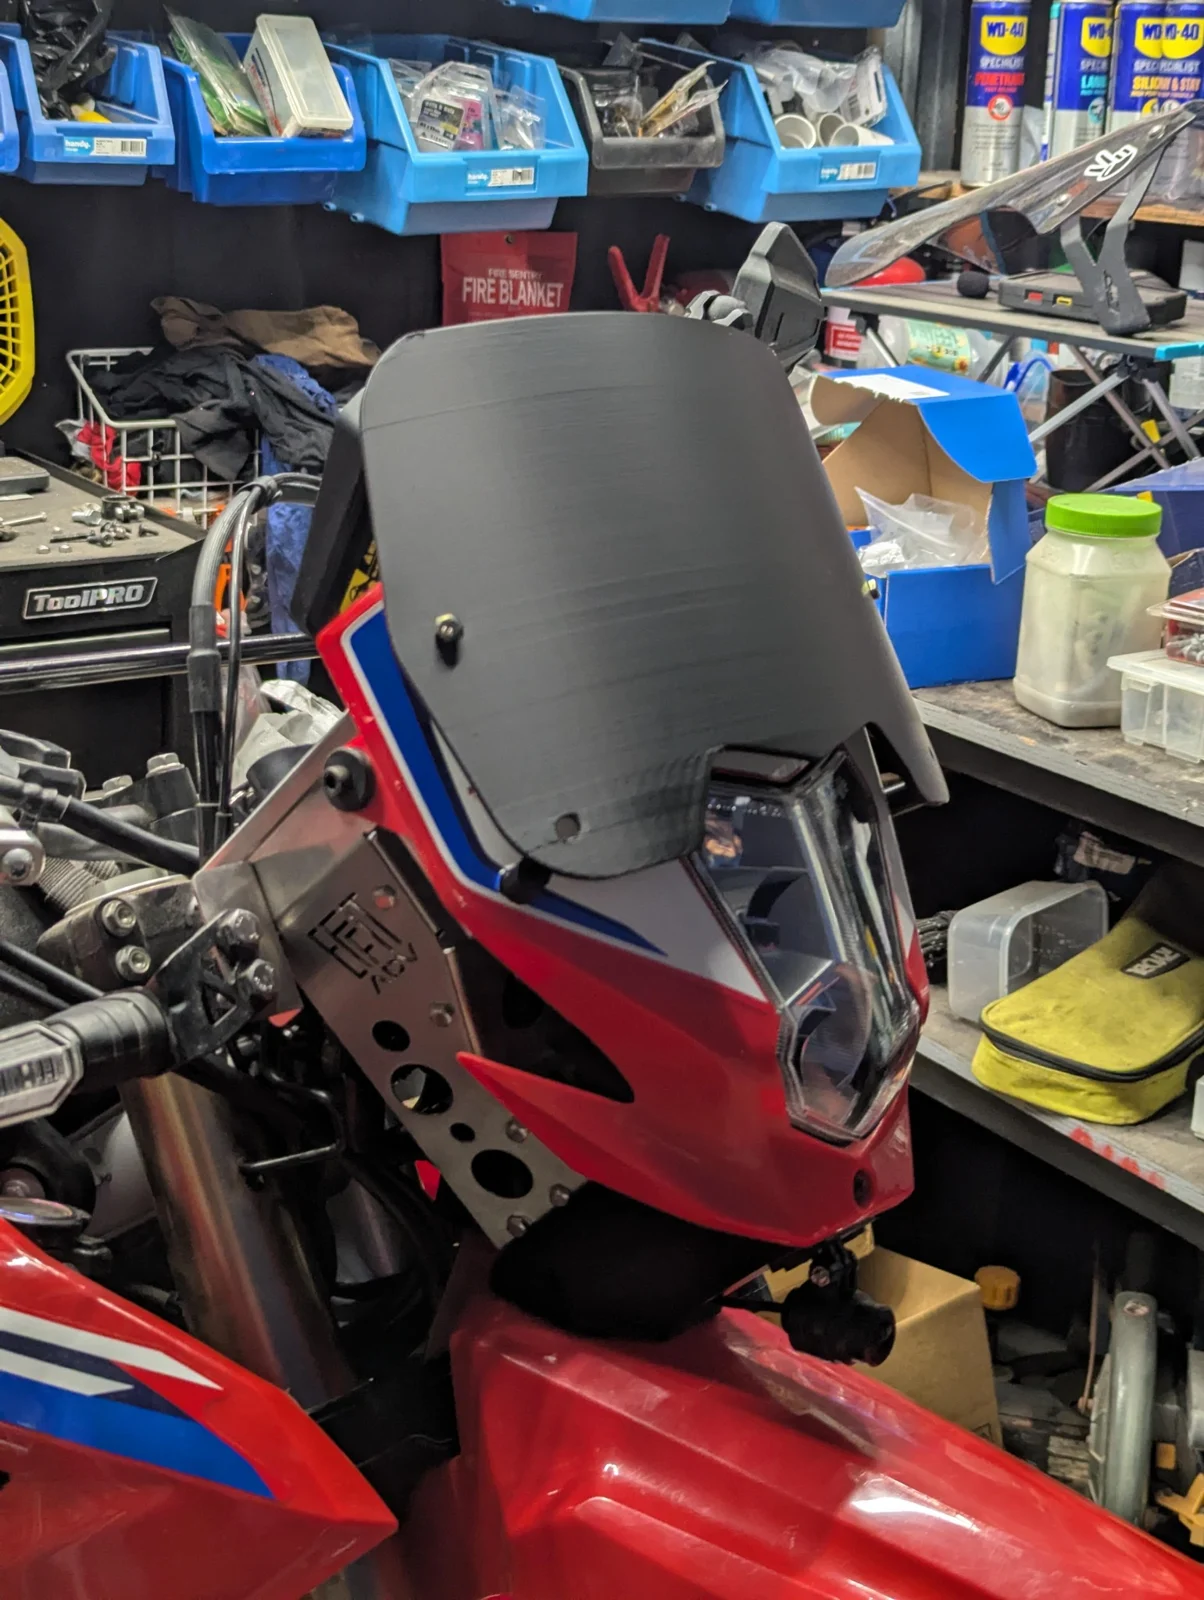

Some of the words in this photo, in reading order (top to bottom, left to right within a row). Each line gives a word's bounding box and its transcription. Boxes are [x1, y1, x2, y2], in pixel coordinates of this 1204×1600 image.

[986, 22, 1024, 37] WD-40
[488, 268, 507, 278] FIRE
[508, 269, 543, 280] SENTRY
[462, 277, 496, 304] FIRE
[499, 279, 564, 308] BLANKET
[33, 584, 144, 613] ToolPRO
